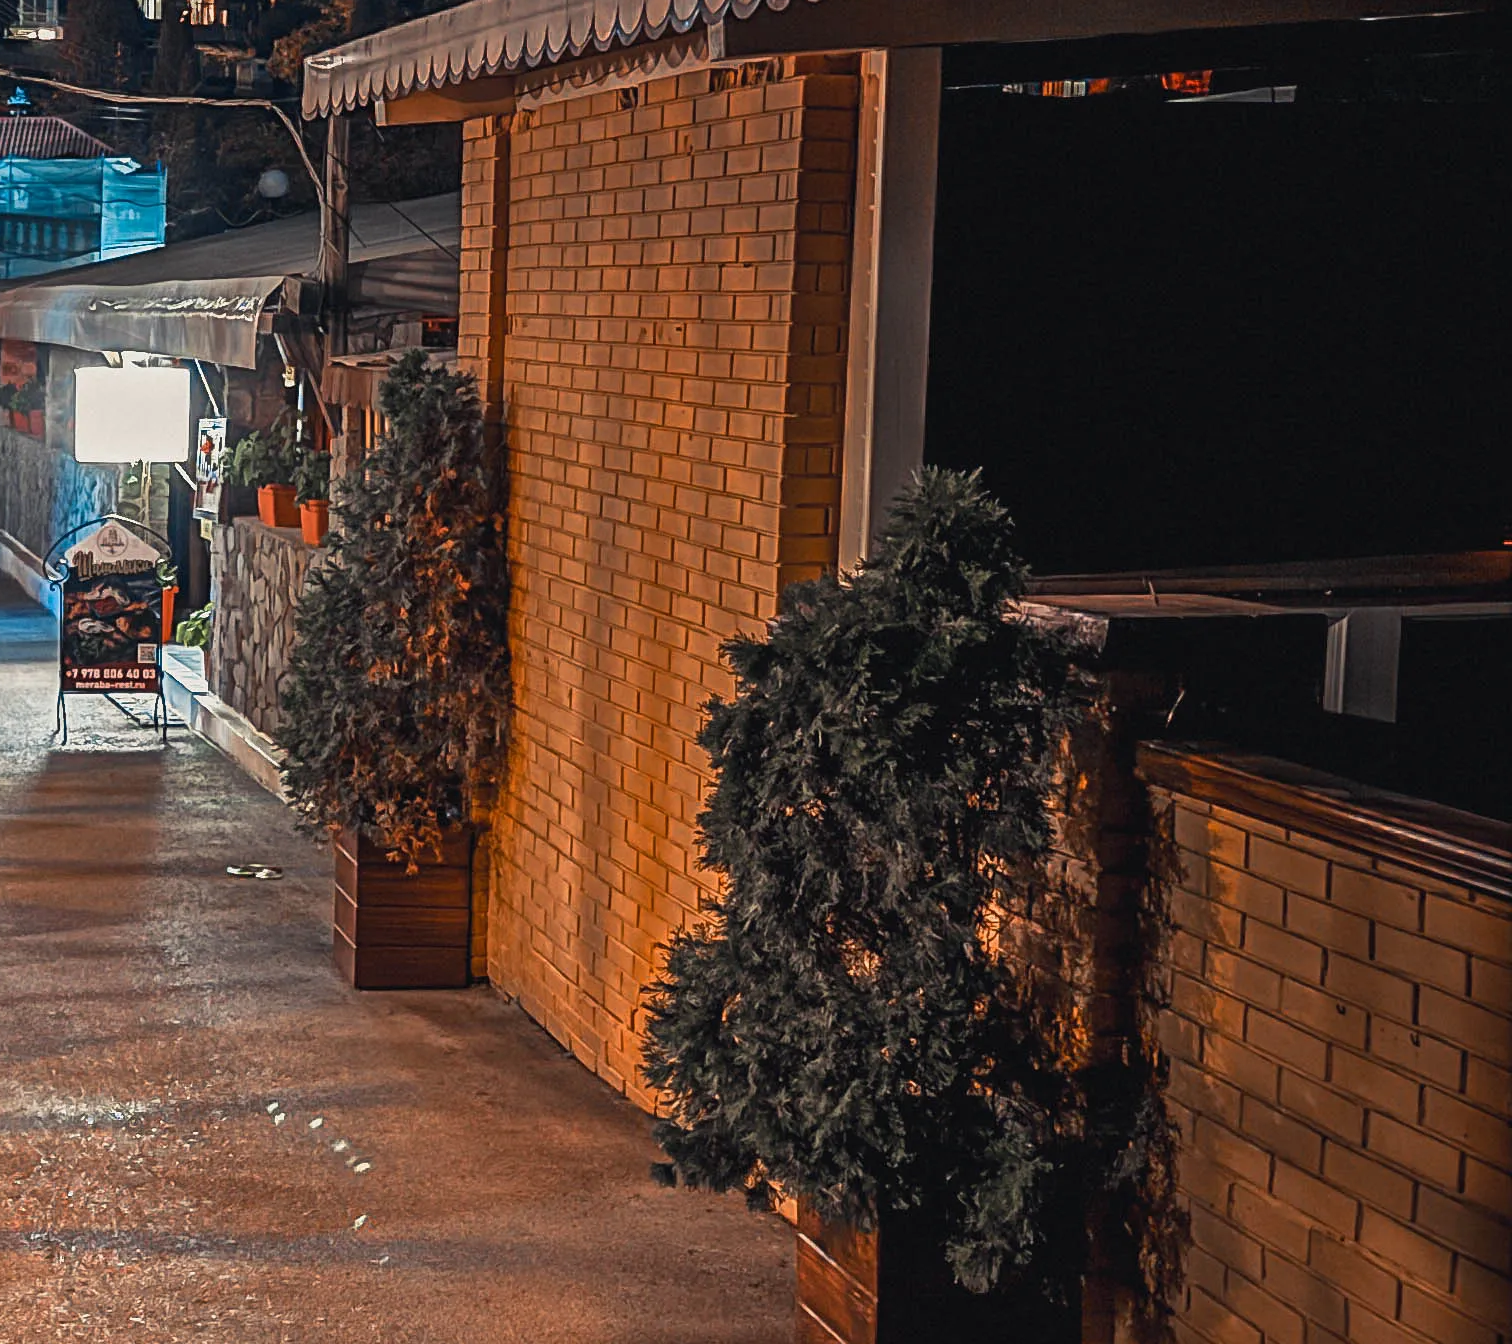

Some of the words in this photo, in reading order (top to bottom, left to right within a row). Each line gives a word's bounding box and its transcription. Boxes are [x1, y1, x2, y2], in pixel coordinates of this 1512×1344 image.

[65, 668, 79, 679] +7
[81, 668, 101, 679] 978
[126, 668, 140, 679] 40
[142, 668, 156, 679] 03
